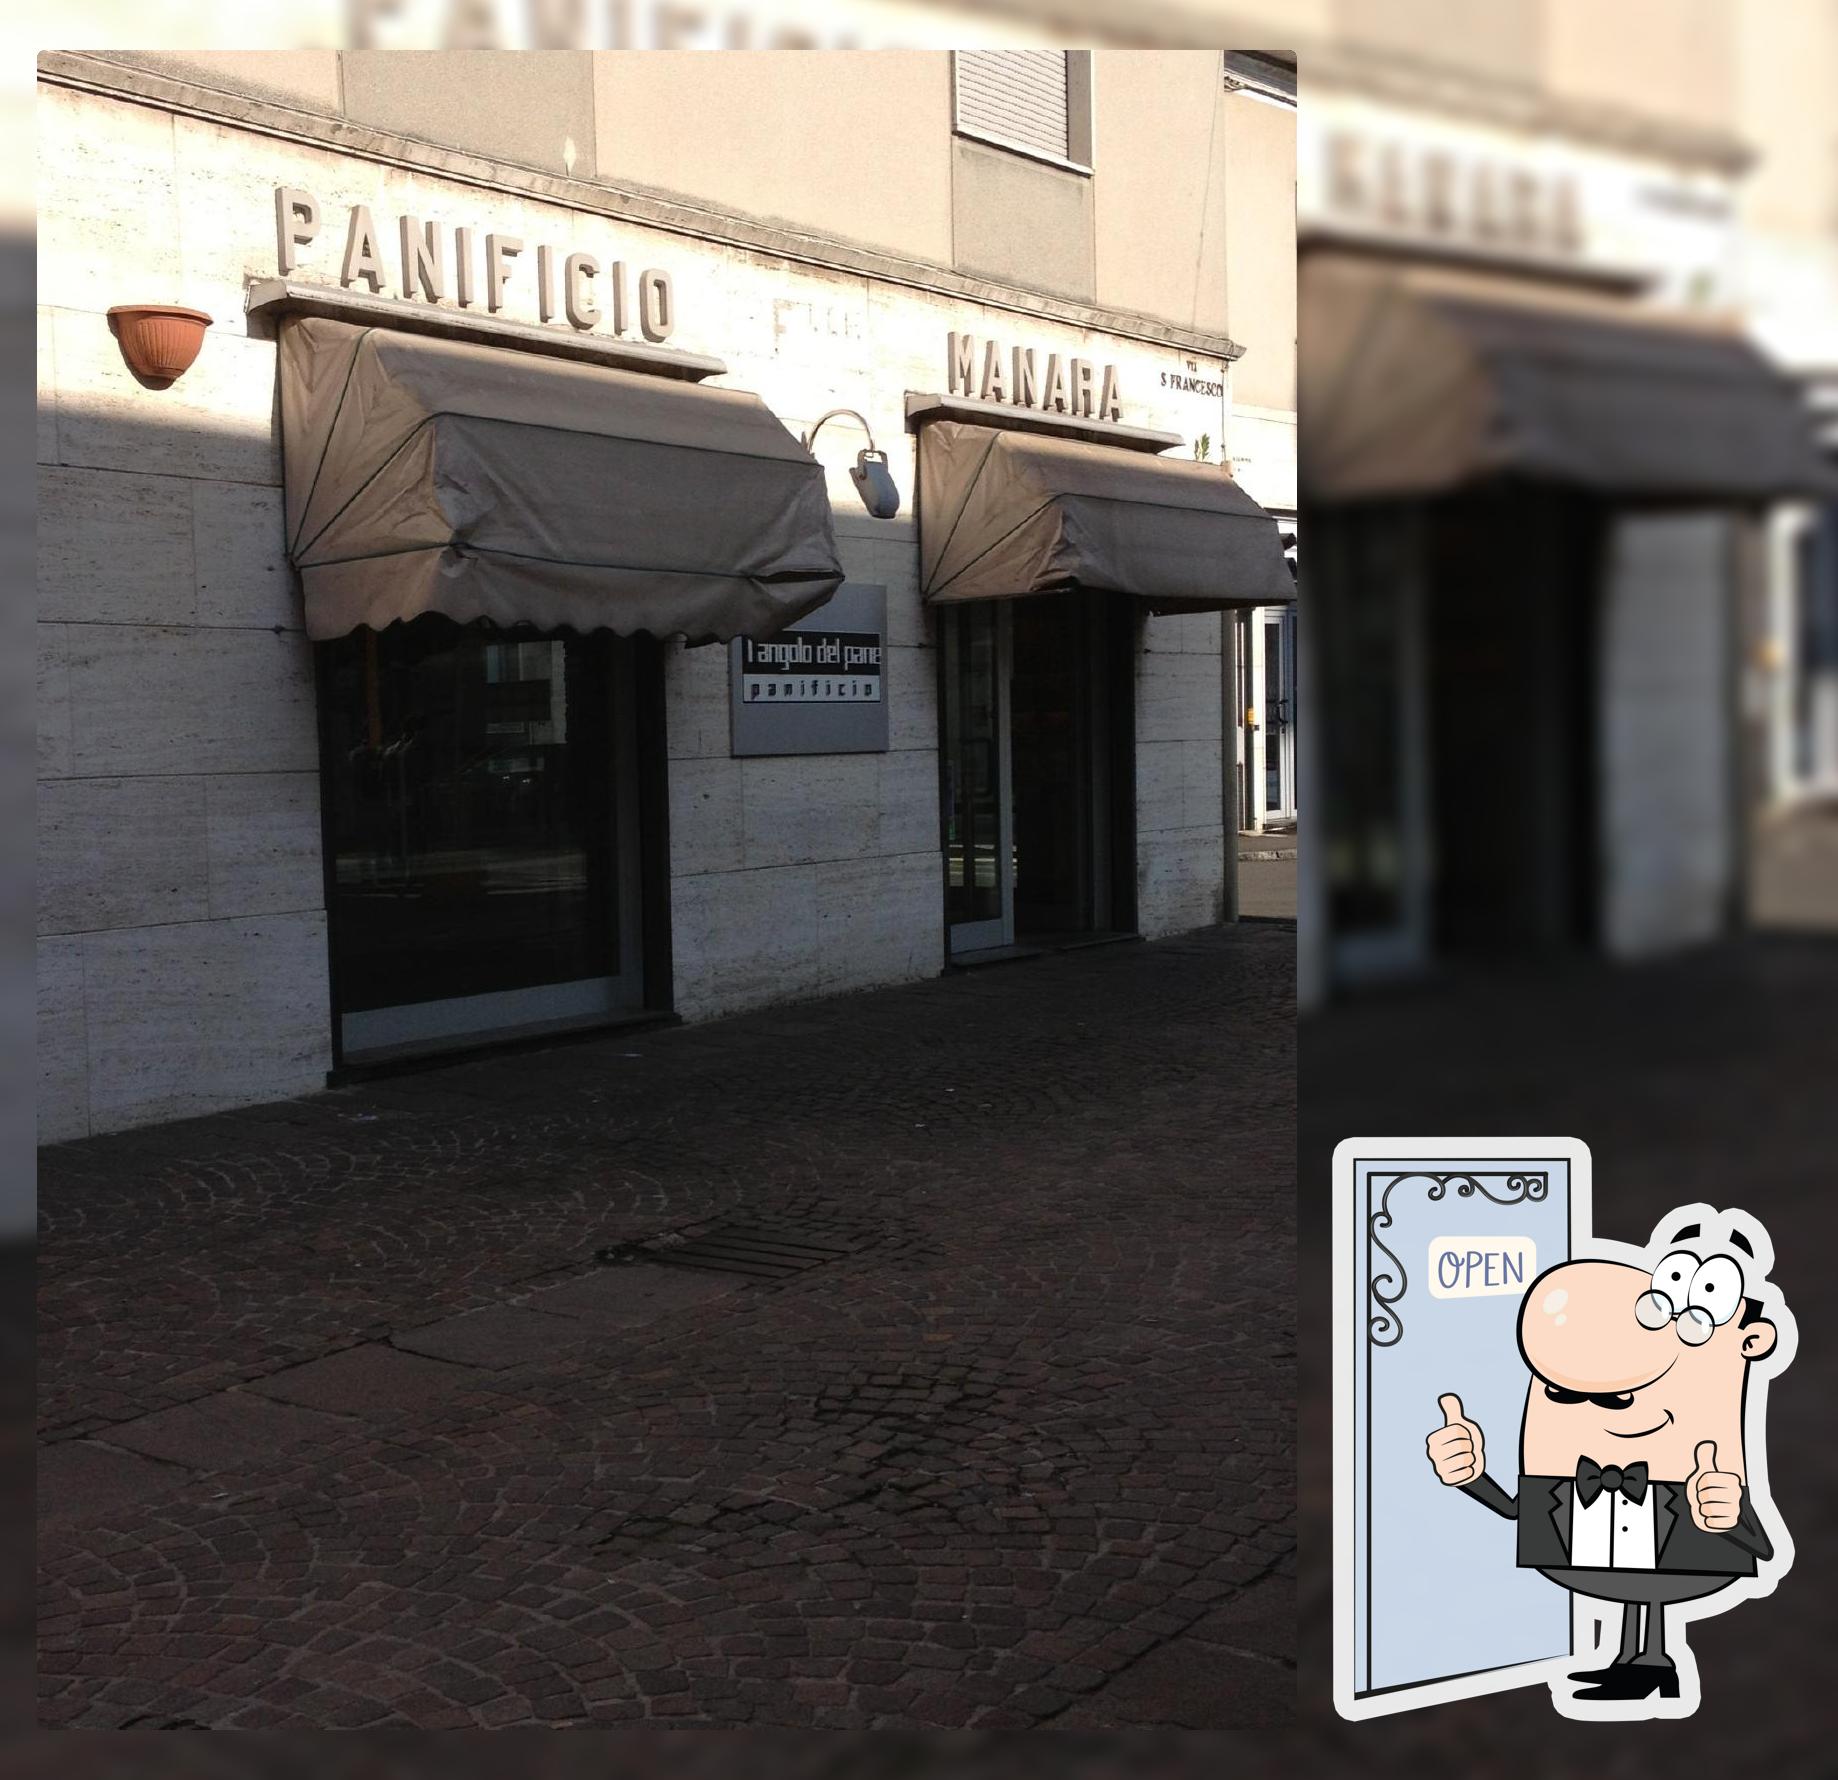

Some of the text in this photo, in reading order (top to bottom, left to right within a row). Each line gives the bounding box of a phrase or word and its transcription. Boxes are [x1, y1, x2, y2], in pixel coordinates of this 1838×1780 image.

[275, 186, 675, 343] PANIFICIO
[947, 331, 1124, 422] MANARA
[1170, 374, 1223, 397] FRANCESCO
[758, 637, 812, 670] angolo
[817, 638, 840, 663] del
[845, 646, 881, 671] pane
[751, 680, 872, 699] panificio
